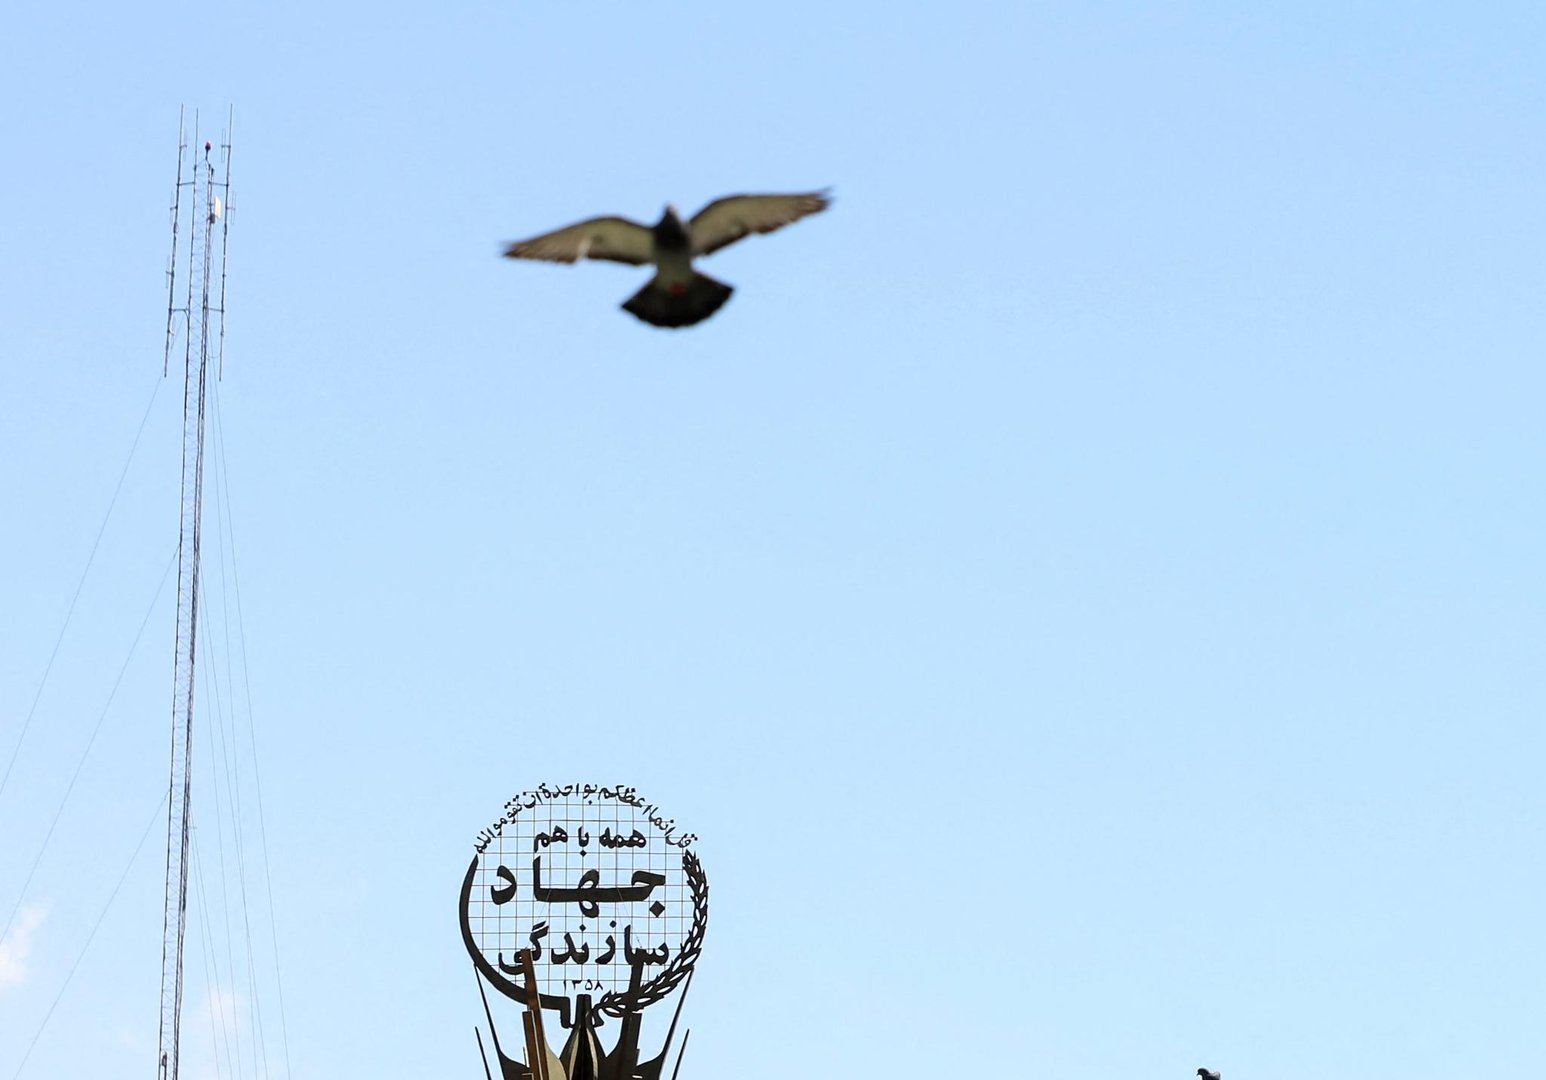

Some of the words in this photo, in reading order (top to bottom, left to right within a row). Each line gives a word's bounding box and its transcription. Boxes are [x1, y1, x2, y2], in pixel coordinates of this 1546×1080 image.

[534, 825, 568, 854] هم
[577, 825, 590, 857] با
[599, 827, 647, 849] همه
[491, 855, 666, 918] جهاد
[498, 920, 669, 976] سازندگی
[562, 979, 604, 991] ۱۳۵۸
